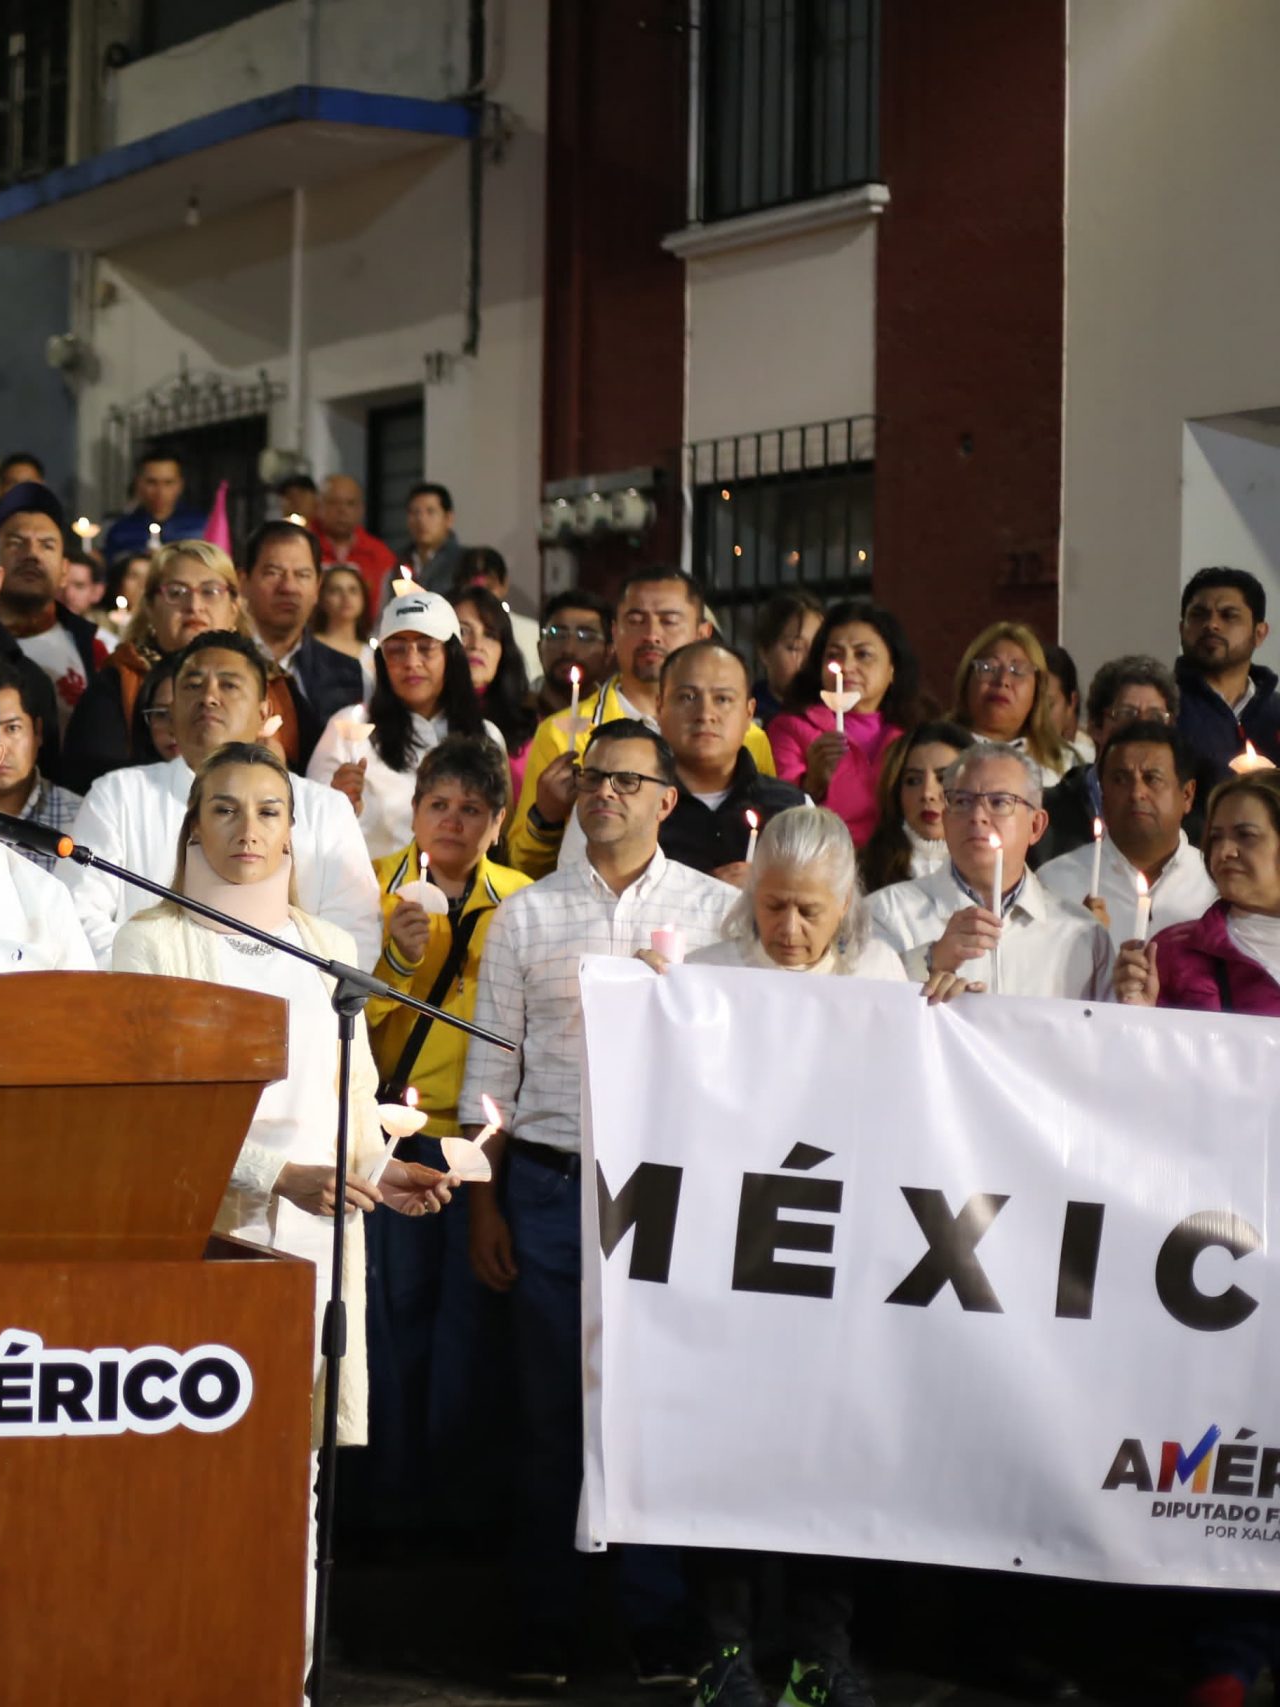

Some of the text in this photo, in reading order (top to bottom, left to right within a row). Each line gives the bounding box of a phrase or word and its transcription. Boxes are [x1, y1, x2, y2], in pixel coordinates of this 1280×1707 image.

[596, 1141, 1263, 1332] MÉXIC
[1151, 1501, 1280, 1524] DIPUTADO F
[1205, 1525, 1238, 1539] POR
